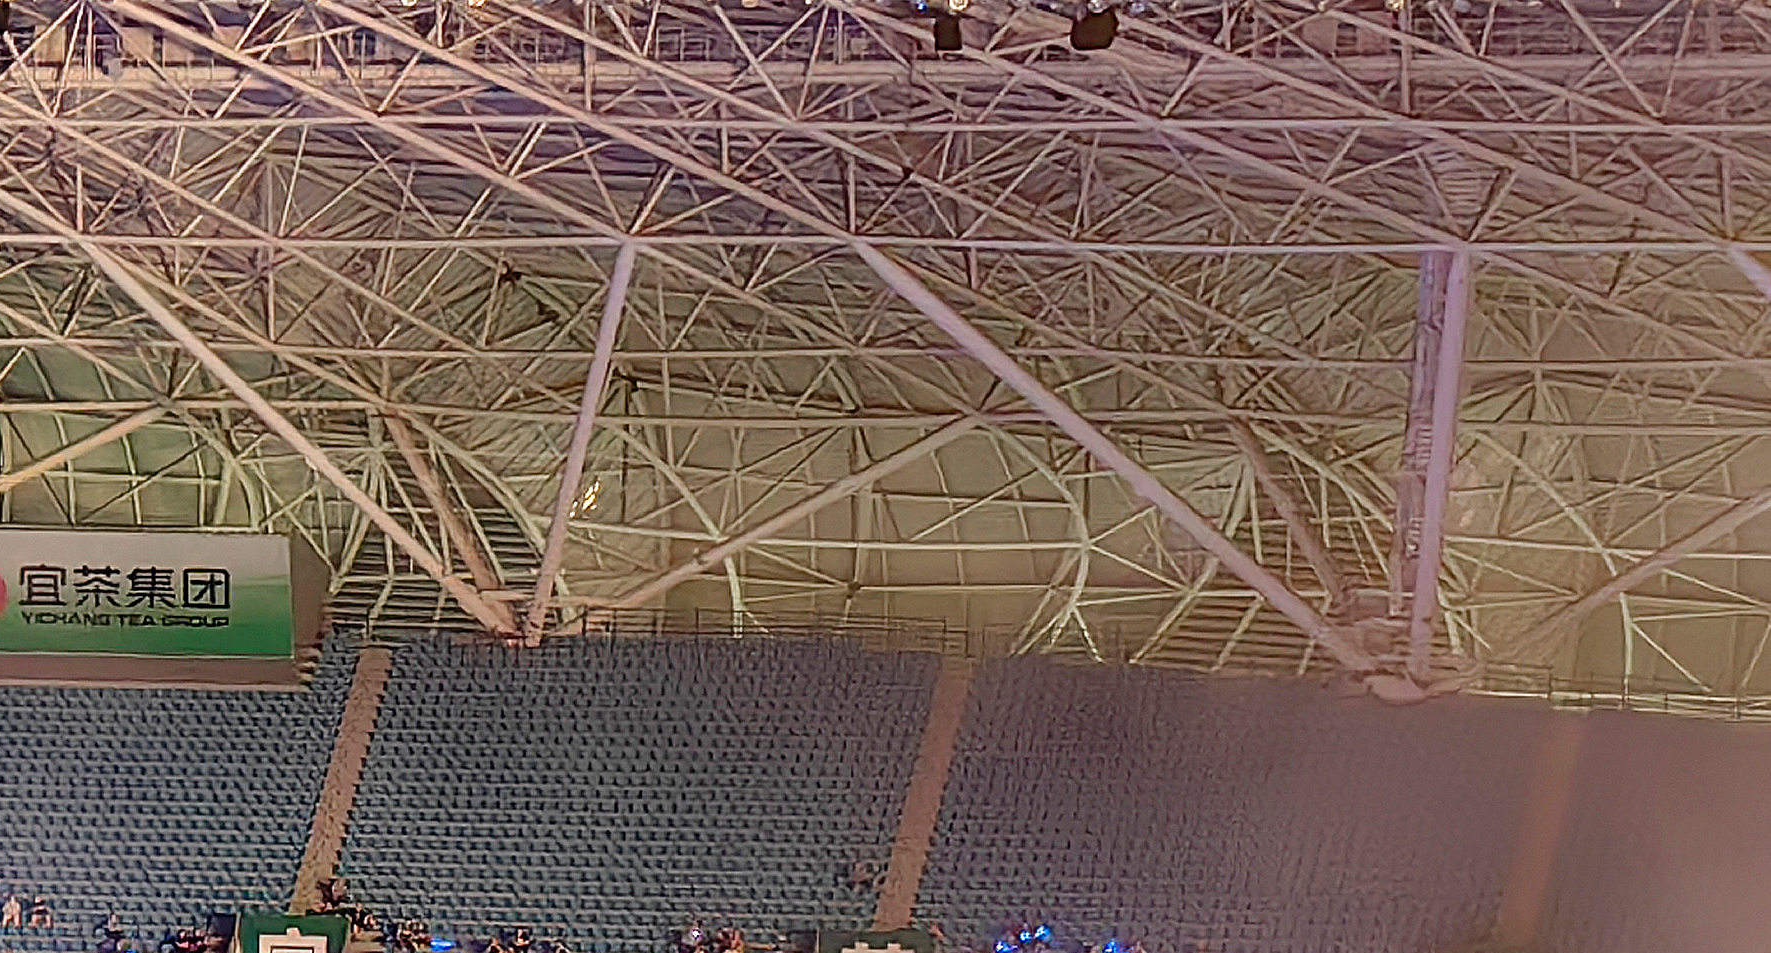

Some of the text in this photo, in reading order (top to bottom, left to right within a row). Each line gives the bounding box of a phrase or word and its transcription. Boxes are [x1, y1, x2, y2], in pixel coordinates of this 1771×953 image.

[18, 564, 231, 609] 宜茶集团
[116, 613, 157, 627] TEA
[161, 614, 230, 628] GROUP
